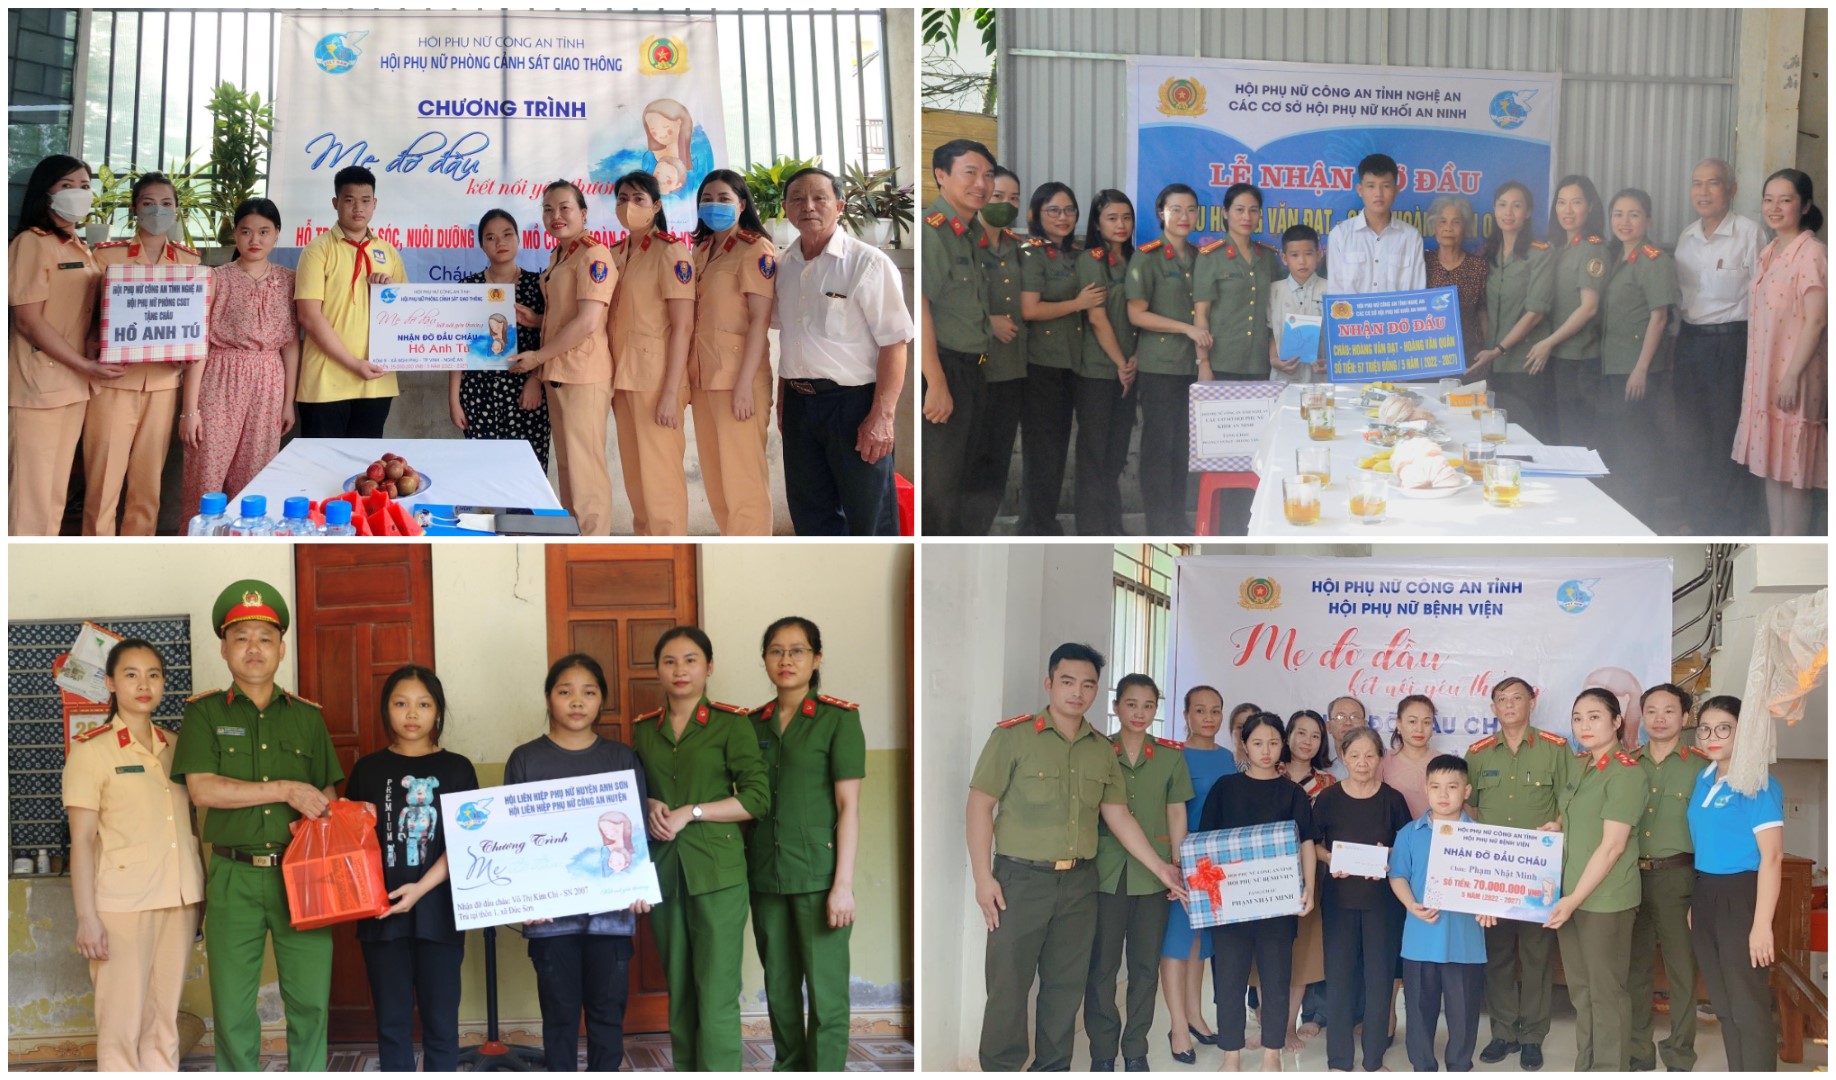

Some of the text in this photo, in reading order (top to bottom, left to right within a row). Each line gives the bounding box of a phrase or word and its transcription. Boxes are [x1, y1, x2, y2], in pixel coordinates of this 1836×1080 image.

[418, 36, 584, 48] HỘI PHỤ NỮ CÔNG AN TỈNH
[381, 51, 622, 73] HỘI PHỤ NỮ PHÒNG CẢNH SÁT GIAO THÔNG
[1235, 83, 1461, 104] HỘI PHỤ NỮ CÔNG AN TỈNH NGHỆ AN
[418, 96, 585, 117] CHƯƠNG TRÌNH
[1229, 99, 1467, 119] CÁC CƠ SỞ HỘI PHỤ NỮ KHỐI AN NINH
[1209, 154, 1481, 196] LỄ NHẬN ĐẦU
[407, 224, 433, 248] NUÔI
[437, 224, 474, 248] DƯỠNG
[160, 285, 167, 293] AN
[145, 310, 173, 322] TẶNG CHÁU
[1339, 313, 1446, 338] NHẬN ĐỠ ĐẦU
[115, 322, 200, 342] HỒ ANH TÚ
[398, 333, 420, 343] NHẬN
[455, 332, 478, 340] CHÁU
[409, 344, 425, 353] Hồ
[429, 344, 452, 352] Anh
[1312, 576, 1523, 598] HỘI PHỤ NỮ CÔNG AN TỈNH
[1328, 600, 1503, 618] HỘI PHỤ NỮ BỆNH VIỆN
[1230, 622, 1313, 671] Mẹ
[504, 781, 628, 807] HỘI LIÊN HIỆP PHỤ NỮ HUYỆN ANH SƠN
[509, 793, 627, 818] HỘI LIÊN HIỆP PHỤ NỮ CÔNG AN HUYỆN
[479, 832, 568, 854] Chương Trình
[1444, 847, 1547, 867] NHẬN ĐỠ ĐẦU CHÁU
[457, 845, 512, 891] Mẹ
[1469, 865, 1537, 880] Phạm Nhật Minh
[563, 889, 573, 897] SN
[574, 886, 588, 895] 2007
[1474, 879, 1526, 895] 70.000.000
